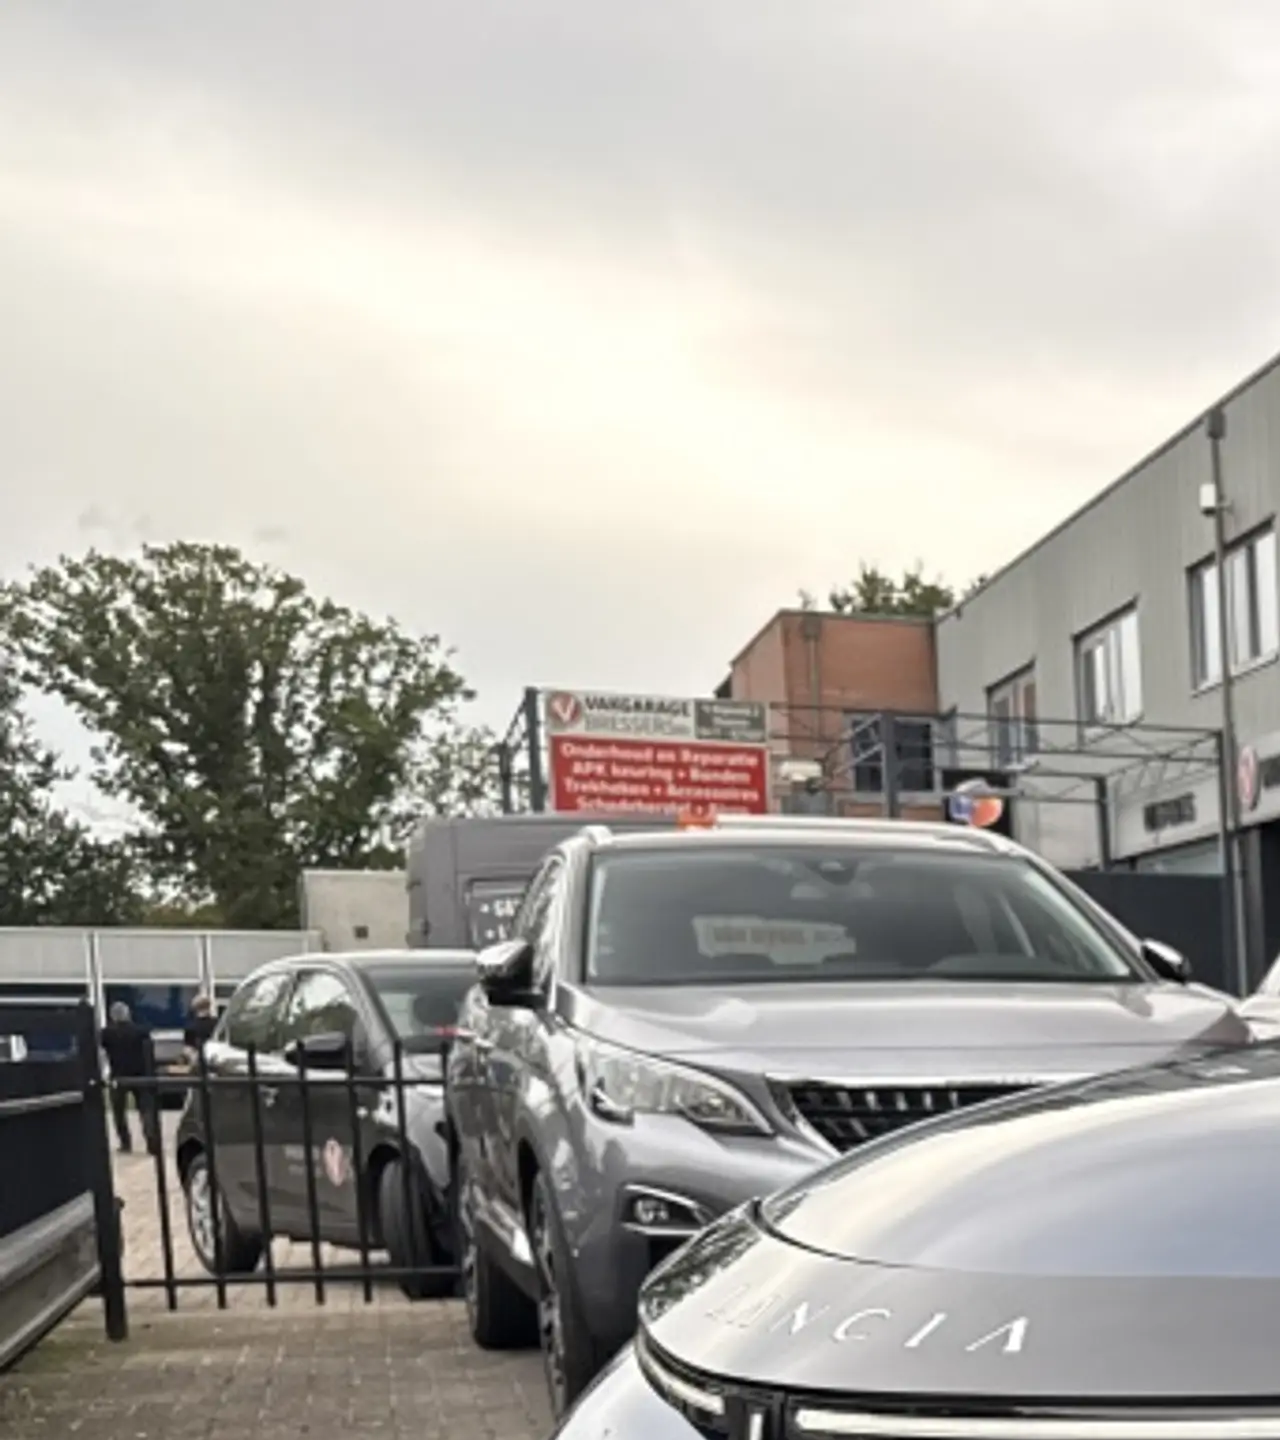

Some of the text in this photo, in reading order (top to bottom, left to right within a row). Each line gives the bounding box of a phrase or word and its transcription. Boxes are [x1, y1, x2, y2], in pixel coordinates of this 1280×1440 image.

[560, 743, 653, 762] Onderhoud
[681, 750, 759, 767] Reparatie
[572, 761, 751, 783] APK keuring Banden
[564, 777, 759, 803] Trekhaken Accessoires
